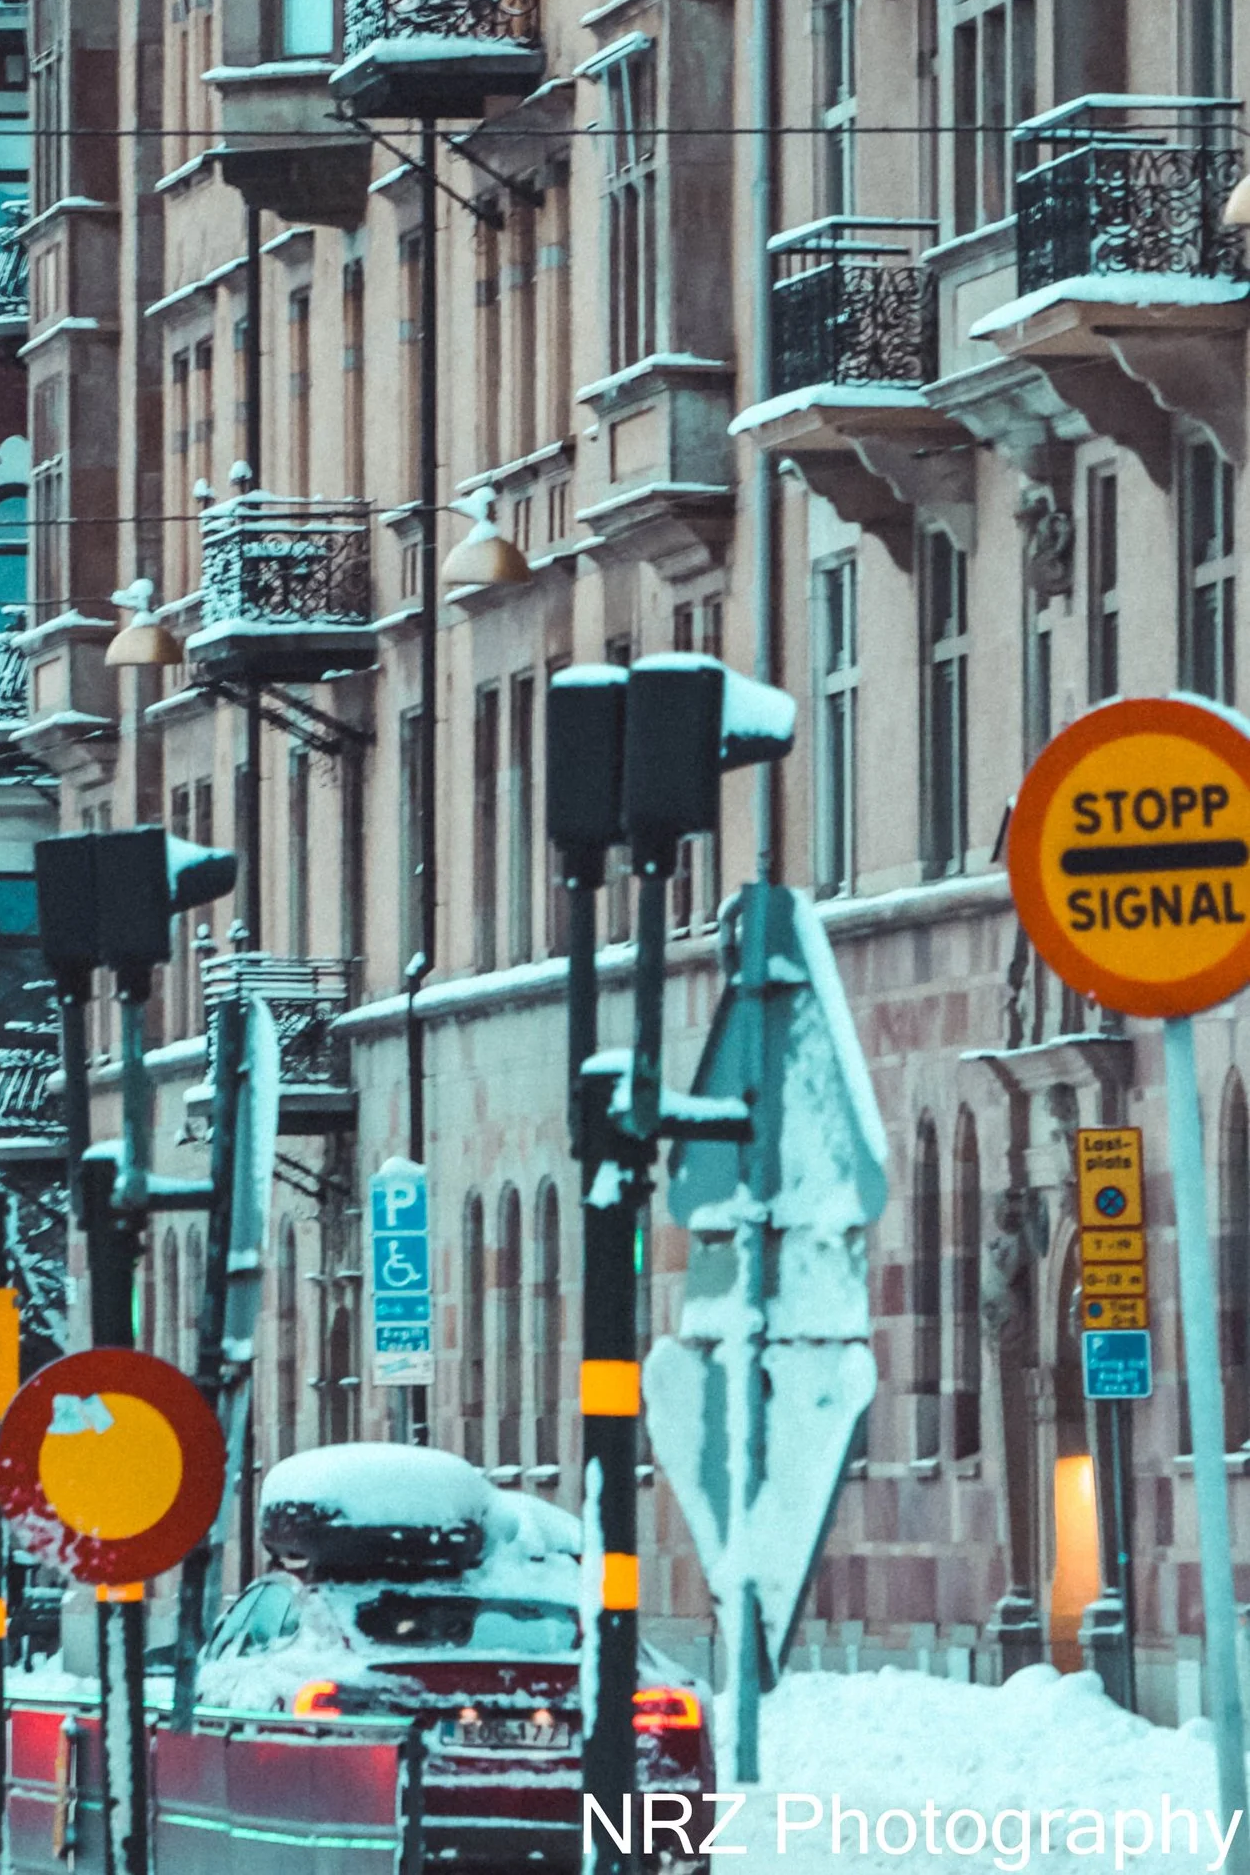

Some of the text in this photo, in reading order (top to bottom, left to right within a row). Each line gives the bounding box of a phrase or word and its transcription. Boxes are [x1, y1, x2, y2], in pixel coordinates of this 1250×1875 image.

[1073, 785, 1229, 834] STOPP
[1067, 882, 1245, 931] SIGNAL
[385, 1181, 417, 1227] P
